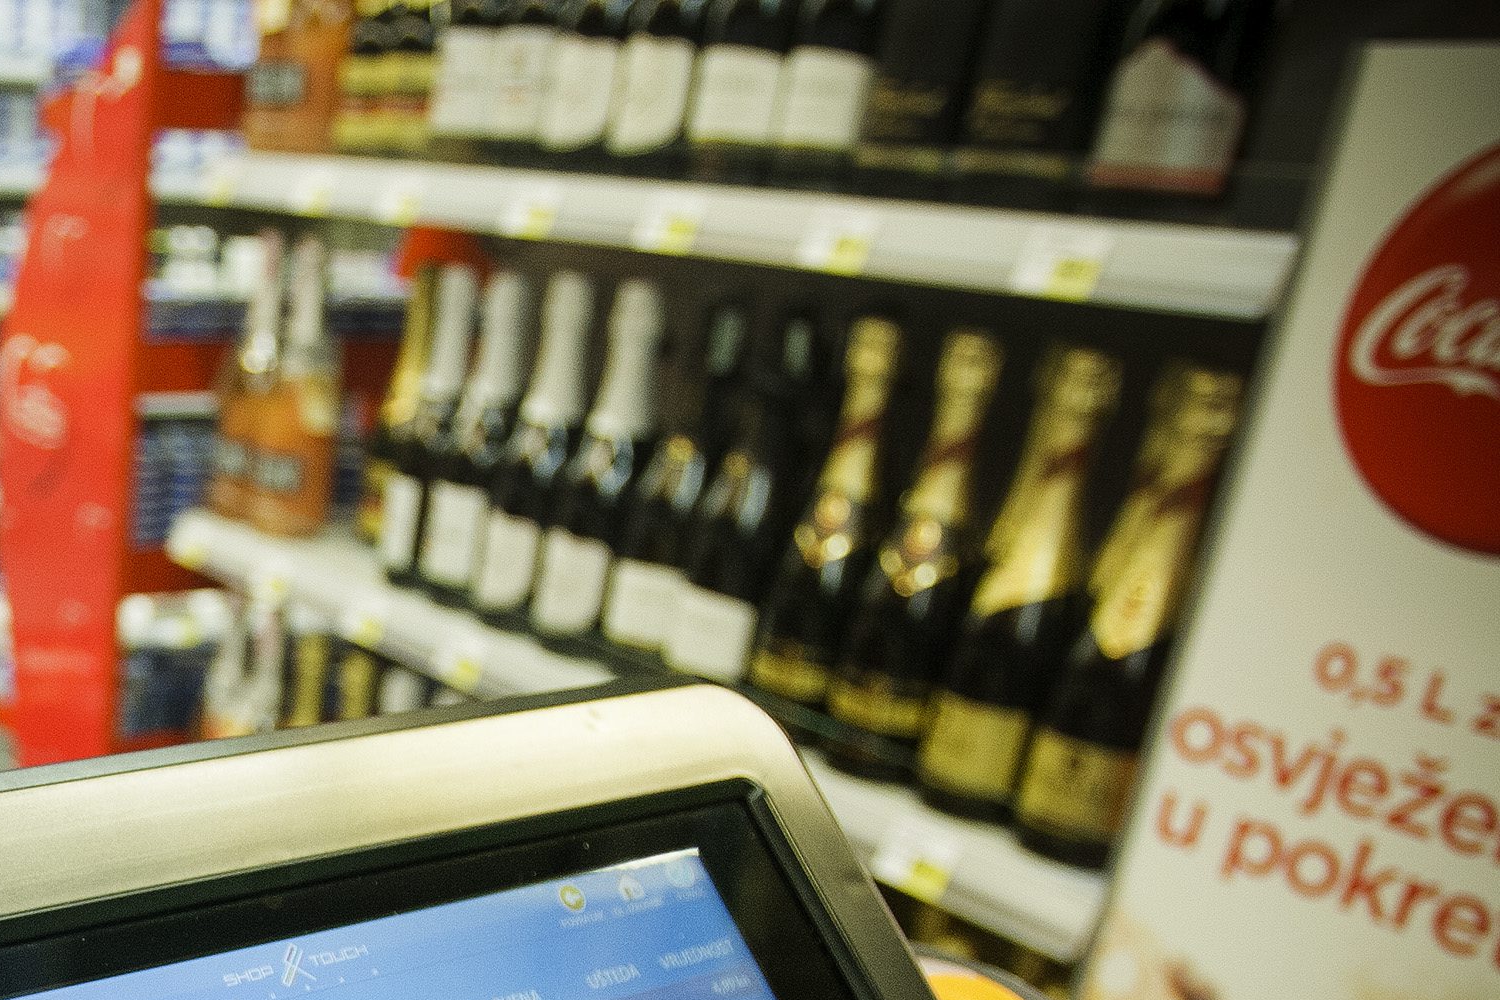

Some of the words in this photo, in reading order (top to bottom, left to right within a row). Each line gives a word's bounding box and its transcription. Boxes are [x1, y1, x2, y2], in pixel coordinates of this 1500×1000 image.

[1420, 668, 1455, 725] L
[1168, 705, 1500, 868] osvježe
[1154, 788, 1208, 849] u
[1220, 815, 1500, 975] pokre
[223, 964, 275, 987] SHOP
[308, 944, 369, 967] TOUCH
